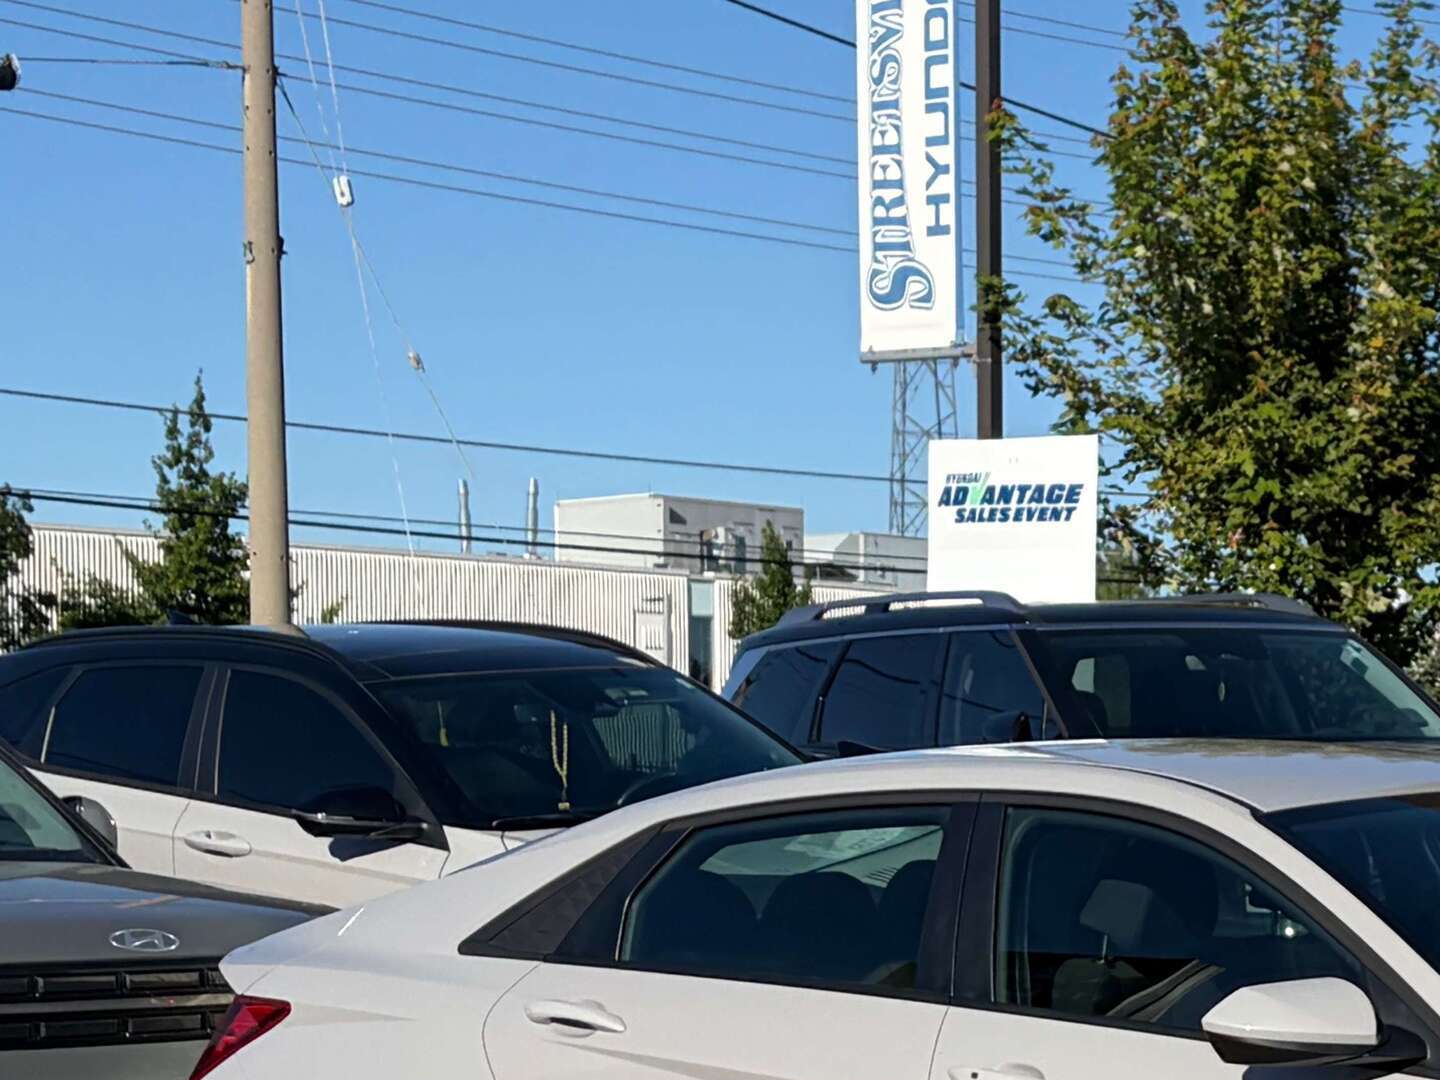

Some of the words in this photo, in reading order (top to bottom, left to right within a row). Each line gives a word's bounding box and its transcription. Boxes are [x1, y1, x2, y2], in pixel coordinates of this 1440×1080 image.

[924, 0, 951, 237] HYUND
[937, 482, 1084, 507] ADVANTAGE
[954, 506, 1012, 524] SALES
[1012, 506, 1078, 523] EVENT
